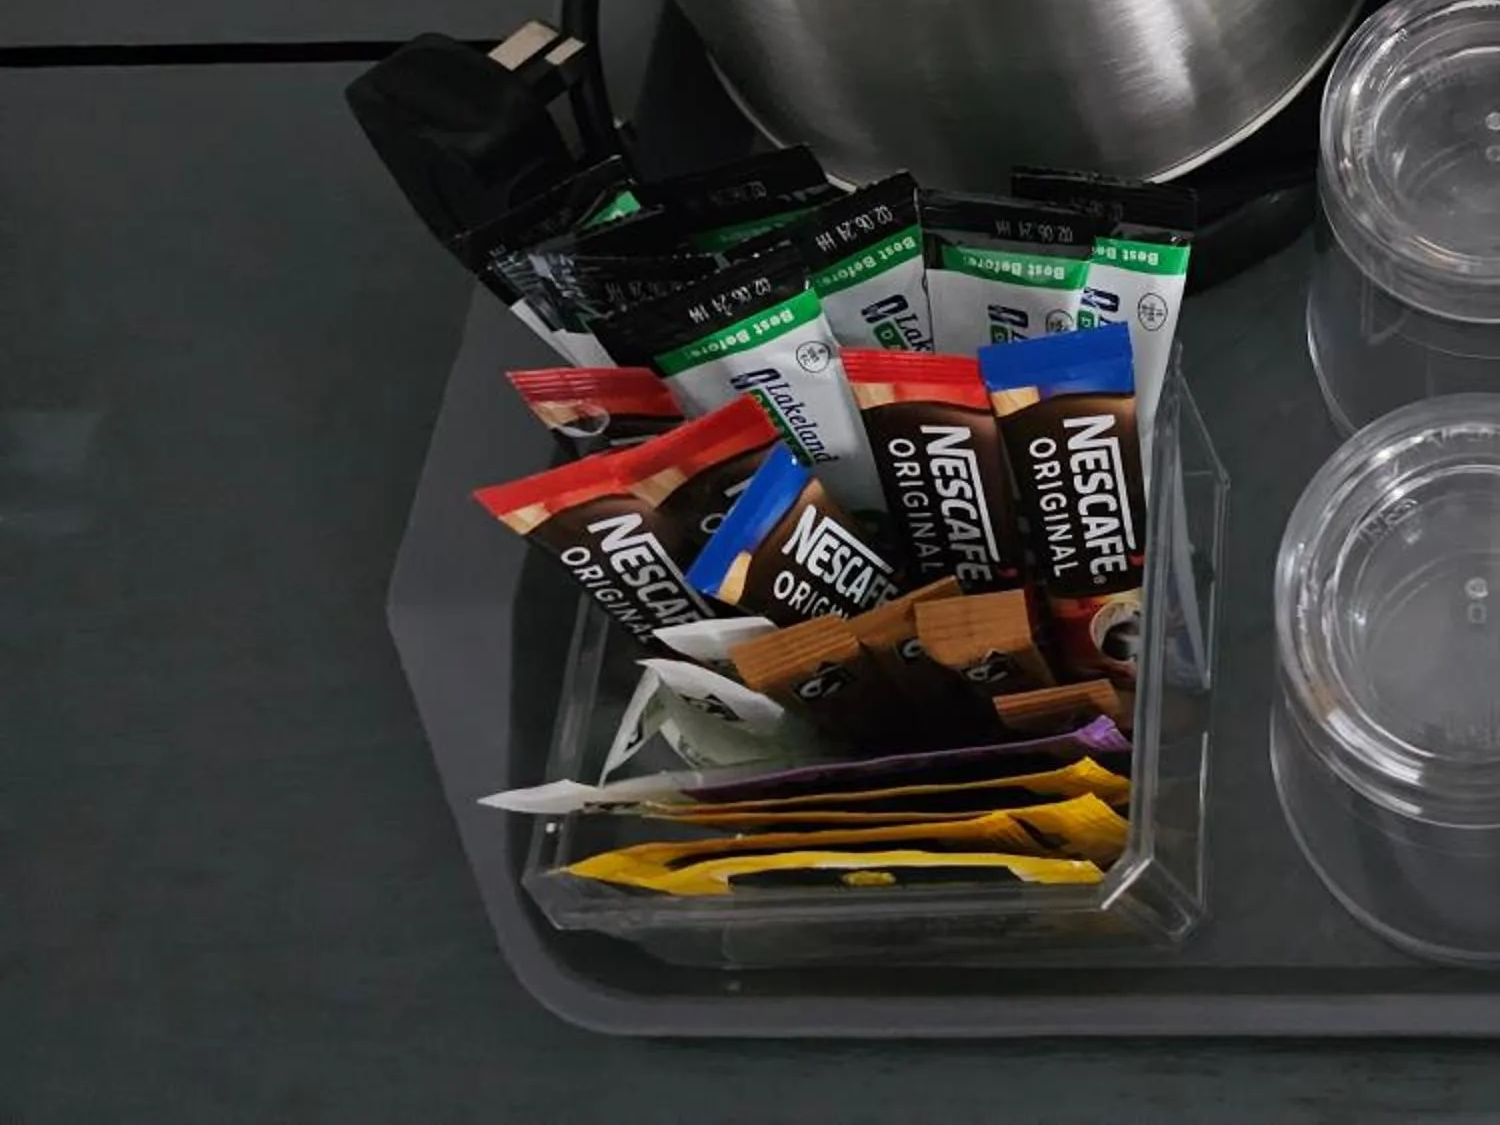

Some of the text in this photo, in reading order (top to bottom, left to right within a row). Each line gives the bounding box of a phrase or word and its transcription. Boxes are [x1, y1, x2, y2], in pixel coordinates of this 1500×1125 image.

[878, 235, 917, 261] Best
[1027, 264, 1065, 280] Best
[1122, 248, 1160, 266] Best
[752, 308, 795, 336] Best
[766, 383, 841, 464] Lakeland
[888, 437, 945, 574] ORIGINAL
[1029, 436, 1080, 578] ORIGINAL
[587, 511, 715, 626] NESCAF
